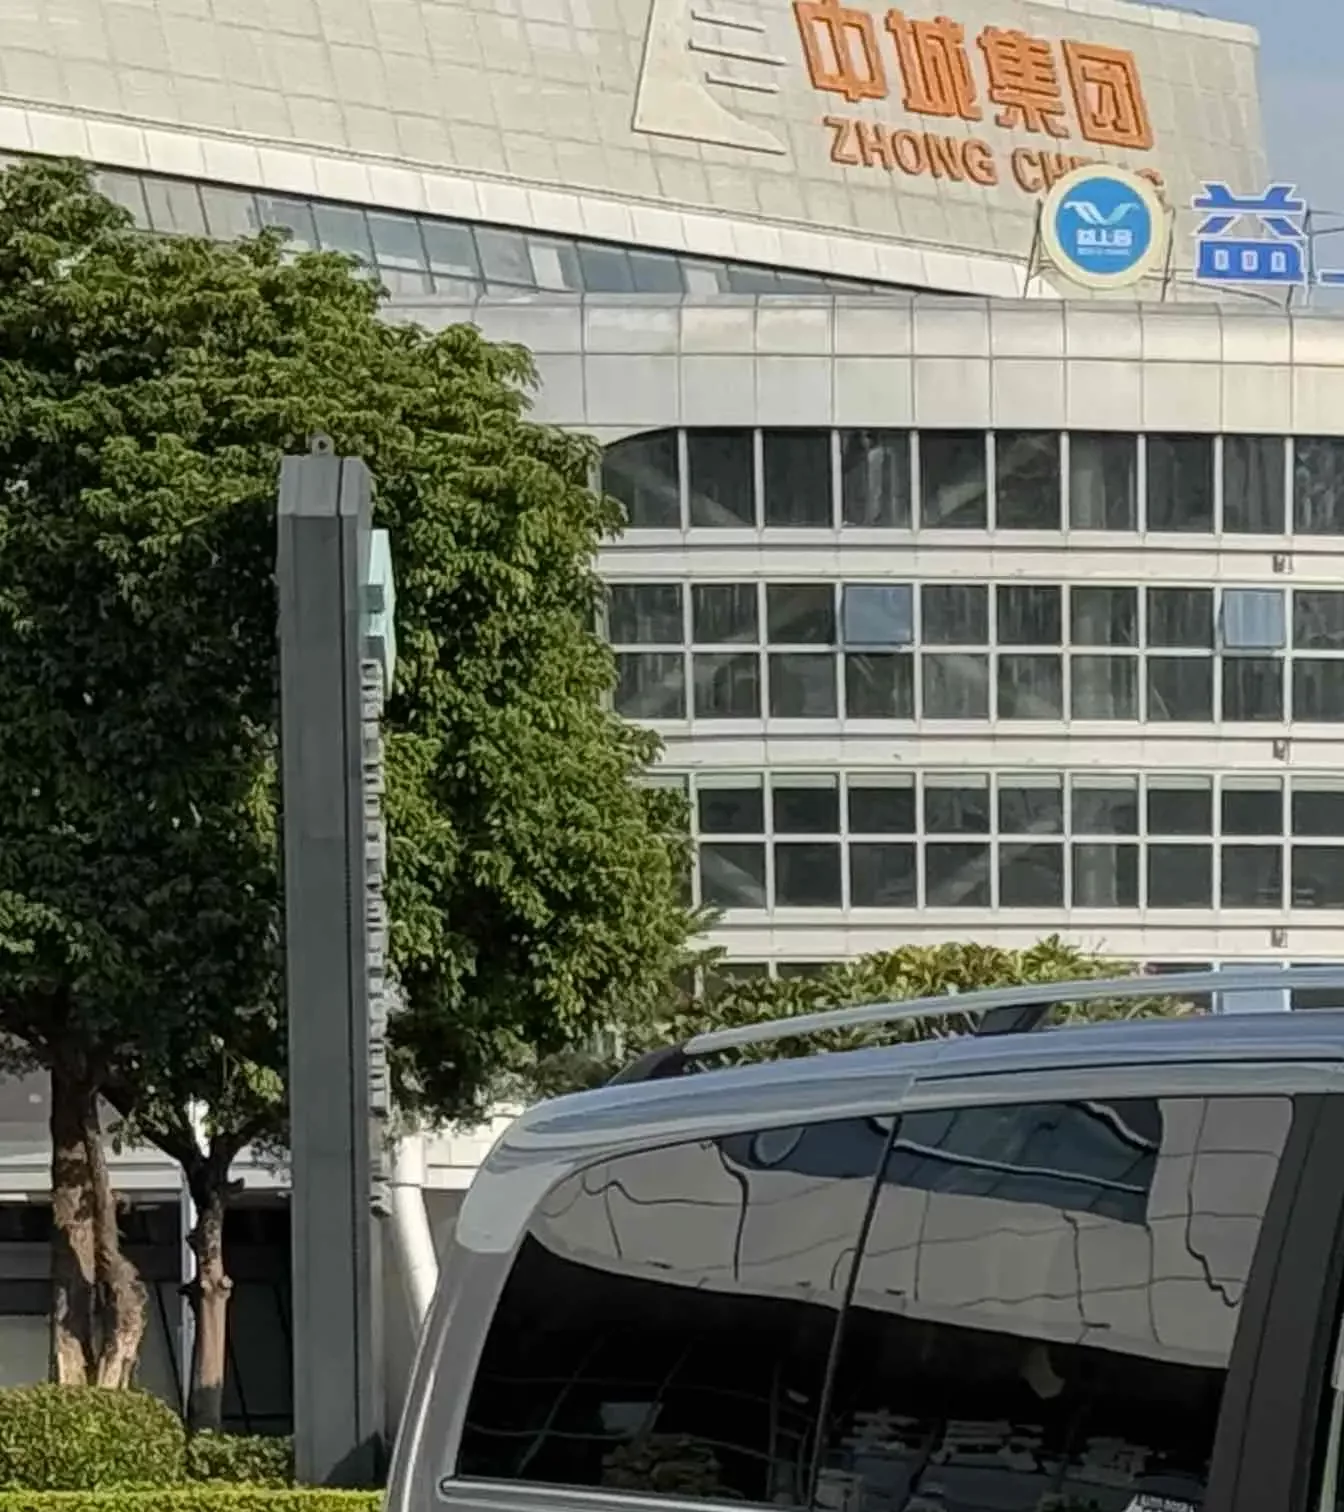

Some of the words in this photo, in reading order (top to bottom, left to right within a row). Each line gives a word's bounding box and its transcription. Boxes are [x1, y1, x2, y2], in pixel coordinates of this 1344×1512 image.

[793, 0, 1153, 150] 中城集团
[823, 115, 998, 186] ZHONG
